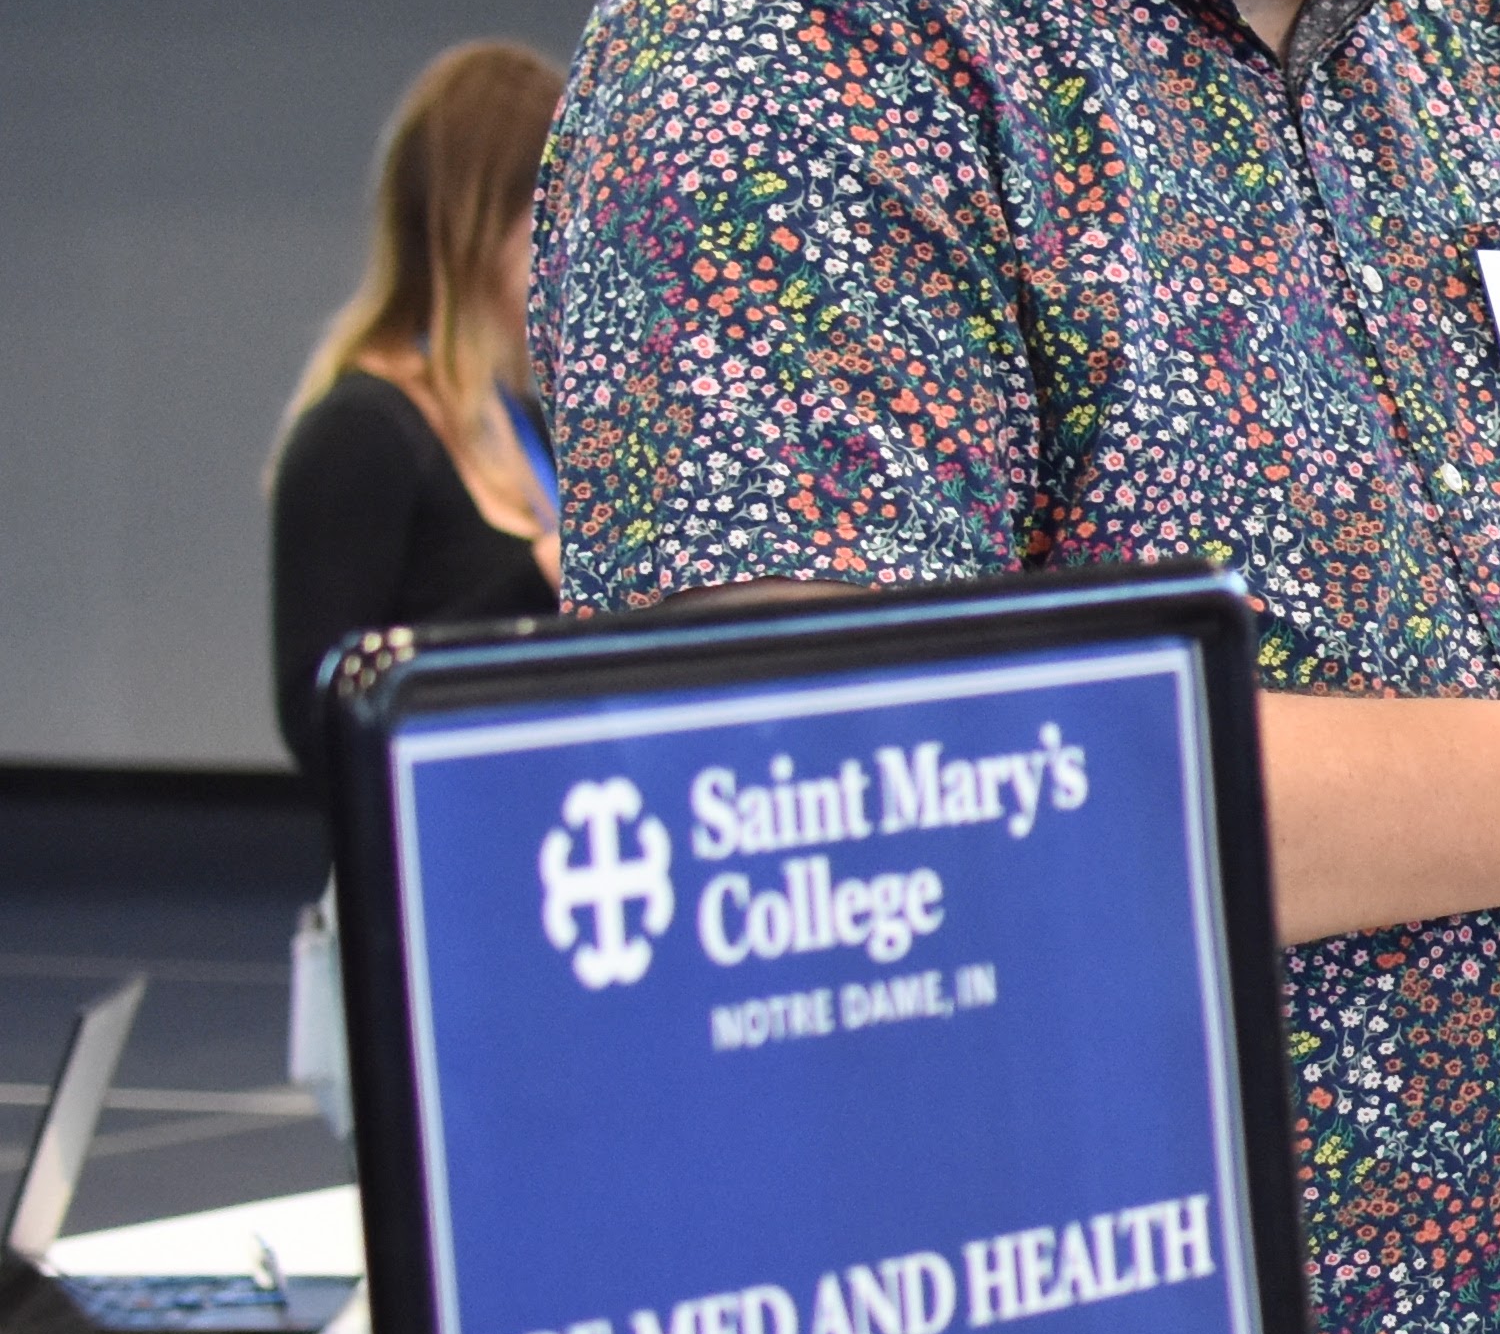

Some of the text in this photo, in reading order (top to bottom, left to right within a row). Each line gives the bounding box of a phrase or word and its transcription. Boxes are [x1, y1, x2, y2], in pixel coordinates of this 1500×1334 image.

[690, 722, 1088, 861] Saint Mary's
[698, 855, 943, 966] College
[710, 963, 997, 1049] NOTRE DAME, IN
[963, 1195, 1216, 1328] HEALTH
